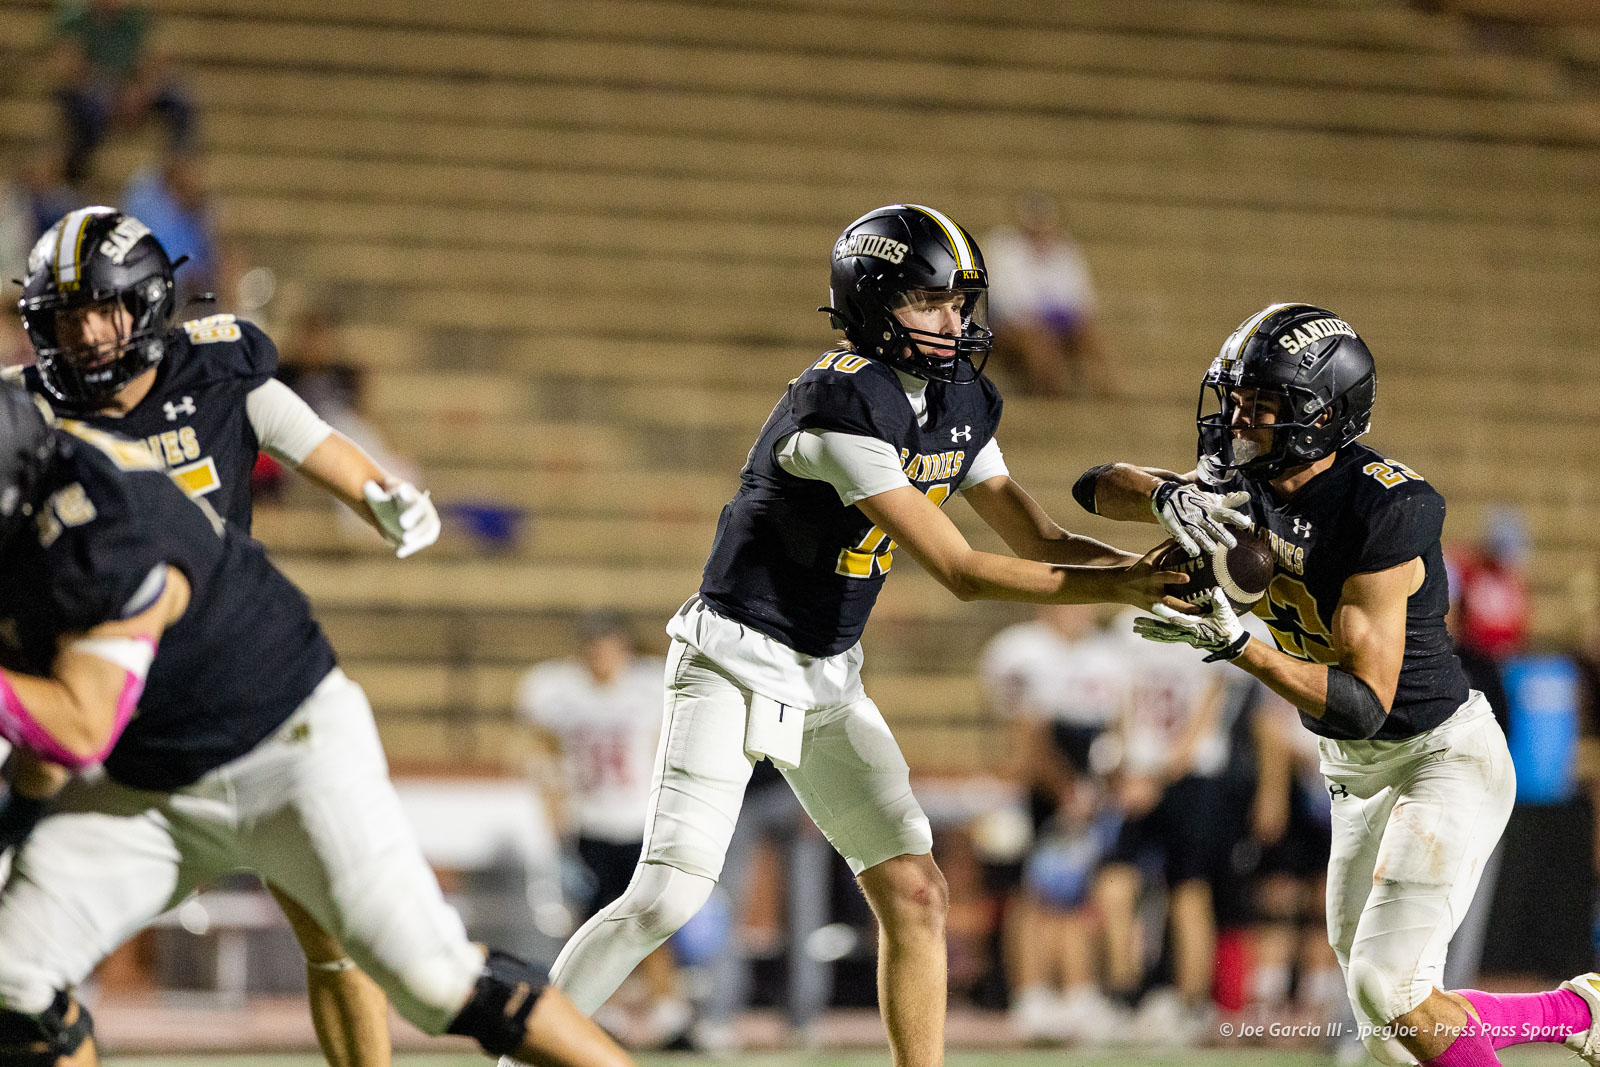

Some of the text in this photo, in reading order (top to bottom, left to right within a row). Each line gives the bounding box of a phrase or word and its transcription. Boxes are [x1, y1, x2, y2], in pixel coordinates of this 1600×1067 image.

[835, 234, 909, 265] SANDIES
[962, 270, 980, 280] KTA
[1279, 318, 1358, 355] SANDIES
[813, 351, 873, 375] 10
